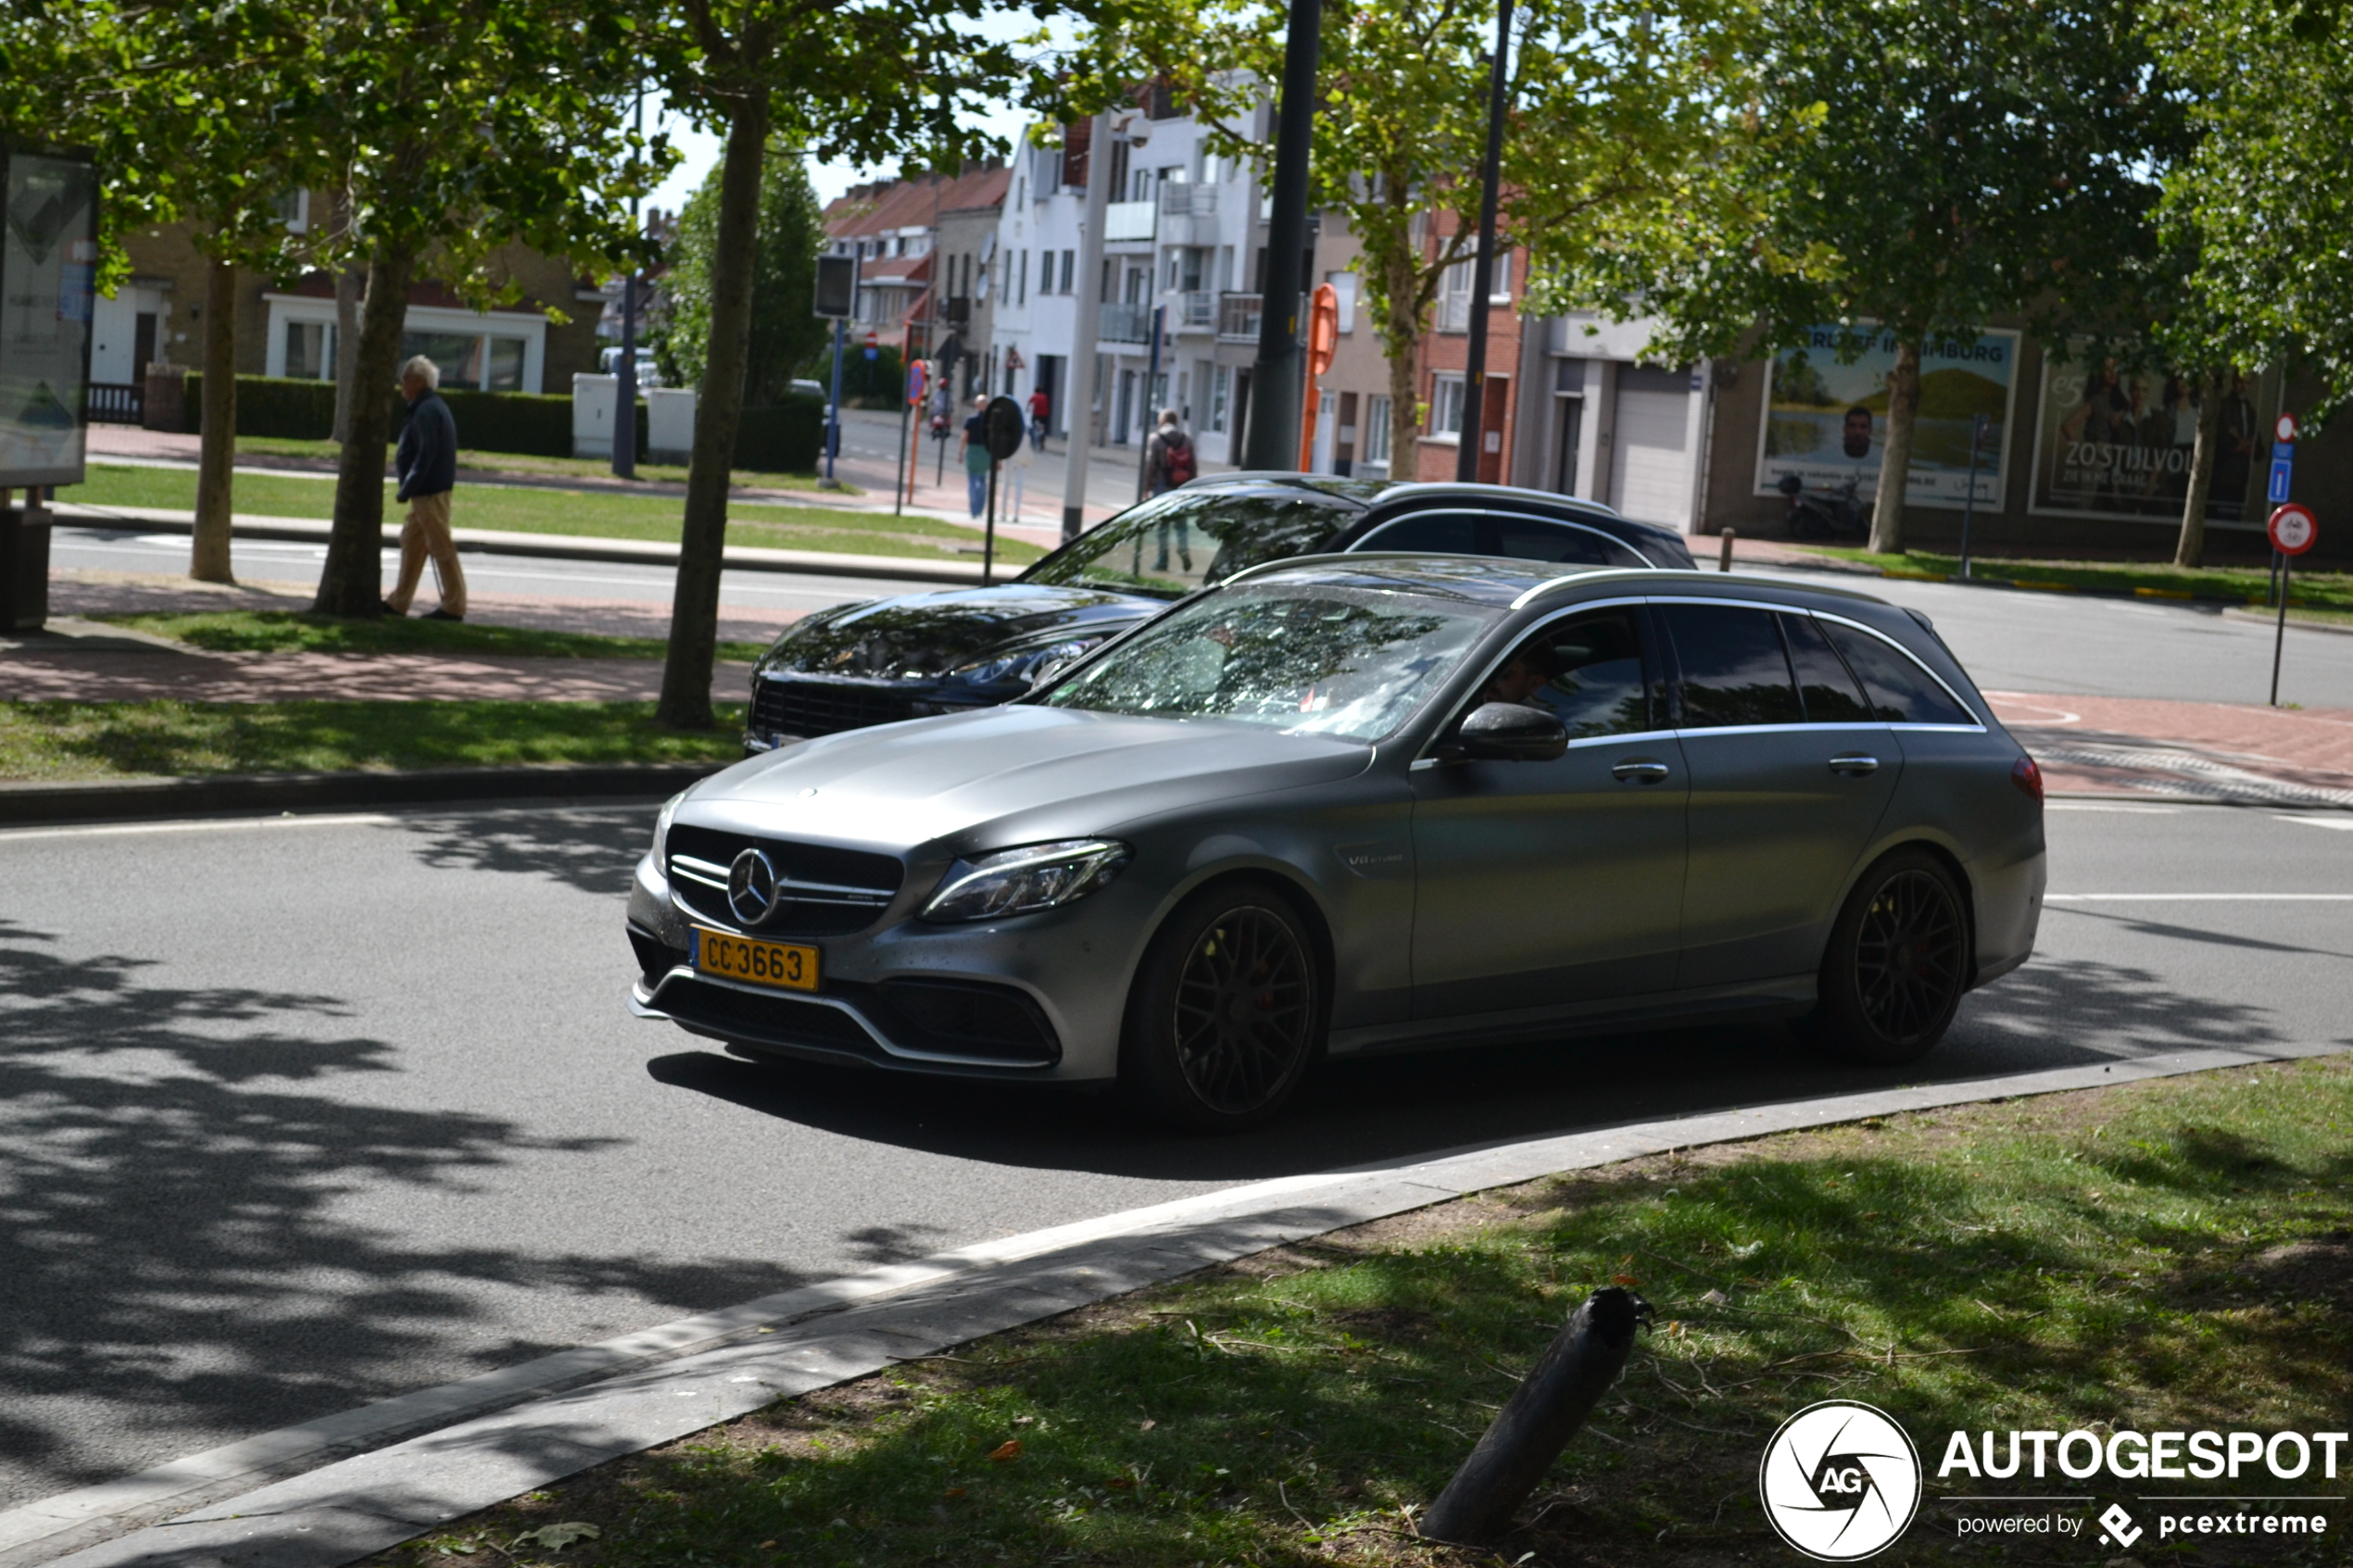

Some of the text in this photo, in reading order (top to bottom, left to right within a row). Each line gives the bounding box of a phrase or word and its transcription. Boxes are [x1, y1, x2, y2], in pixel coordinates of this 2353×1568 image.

[2065, 441, 2193, 475] ZO STIJLVOL
[1348, 854, 1368, 866] V8
